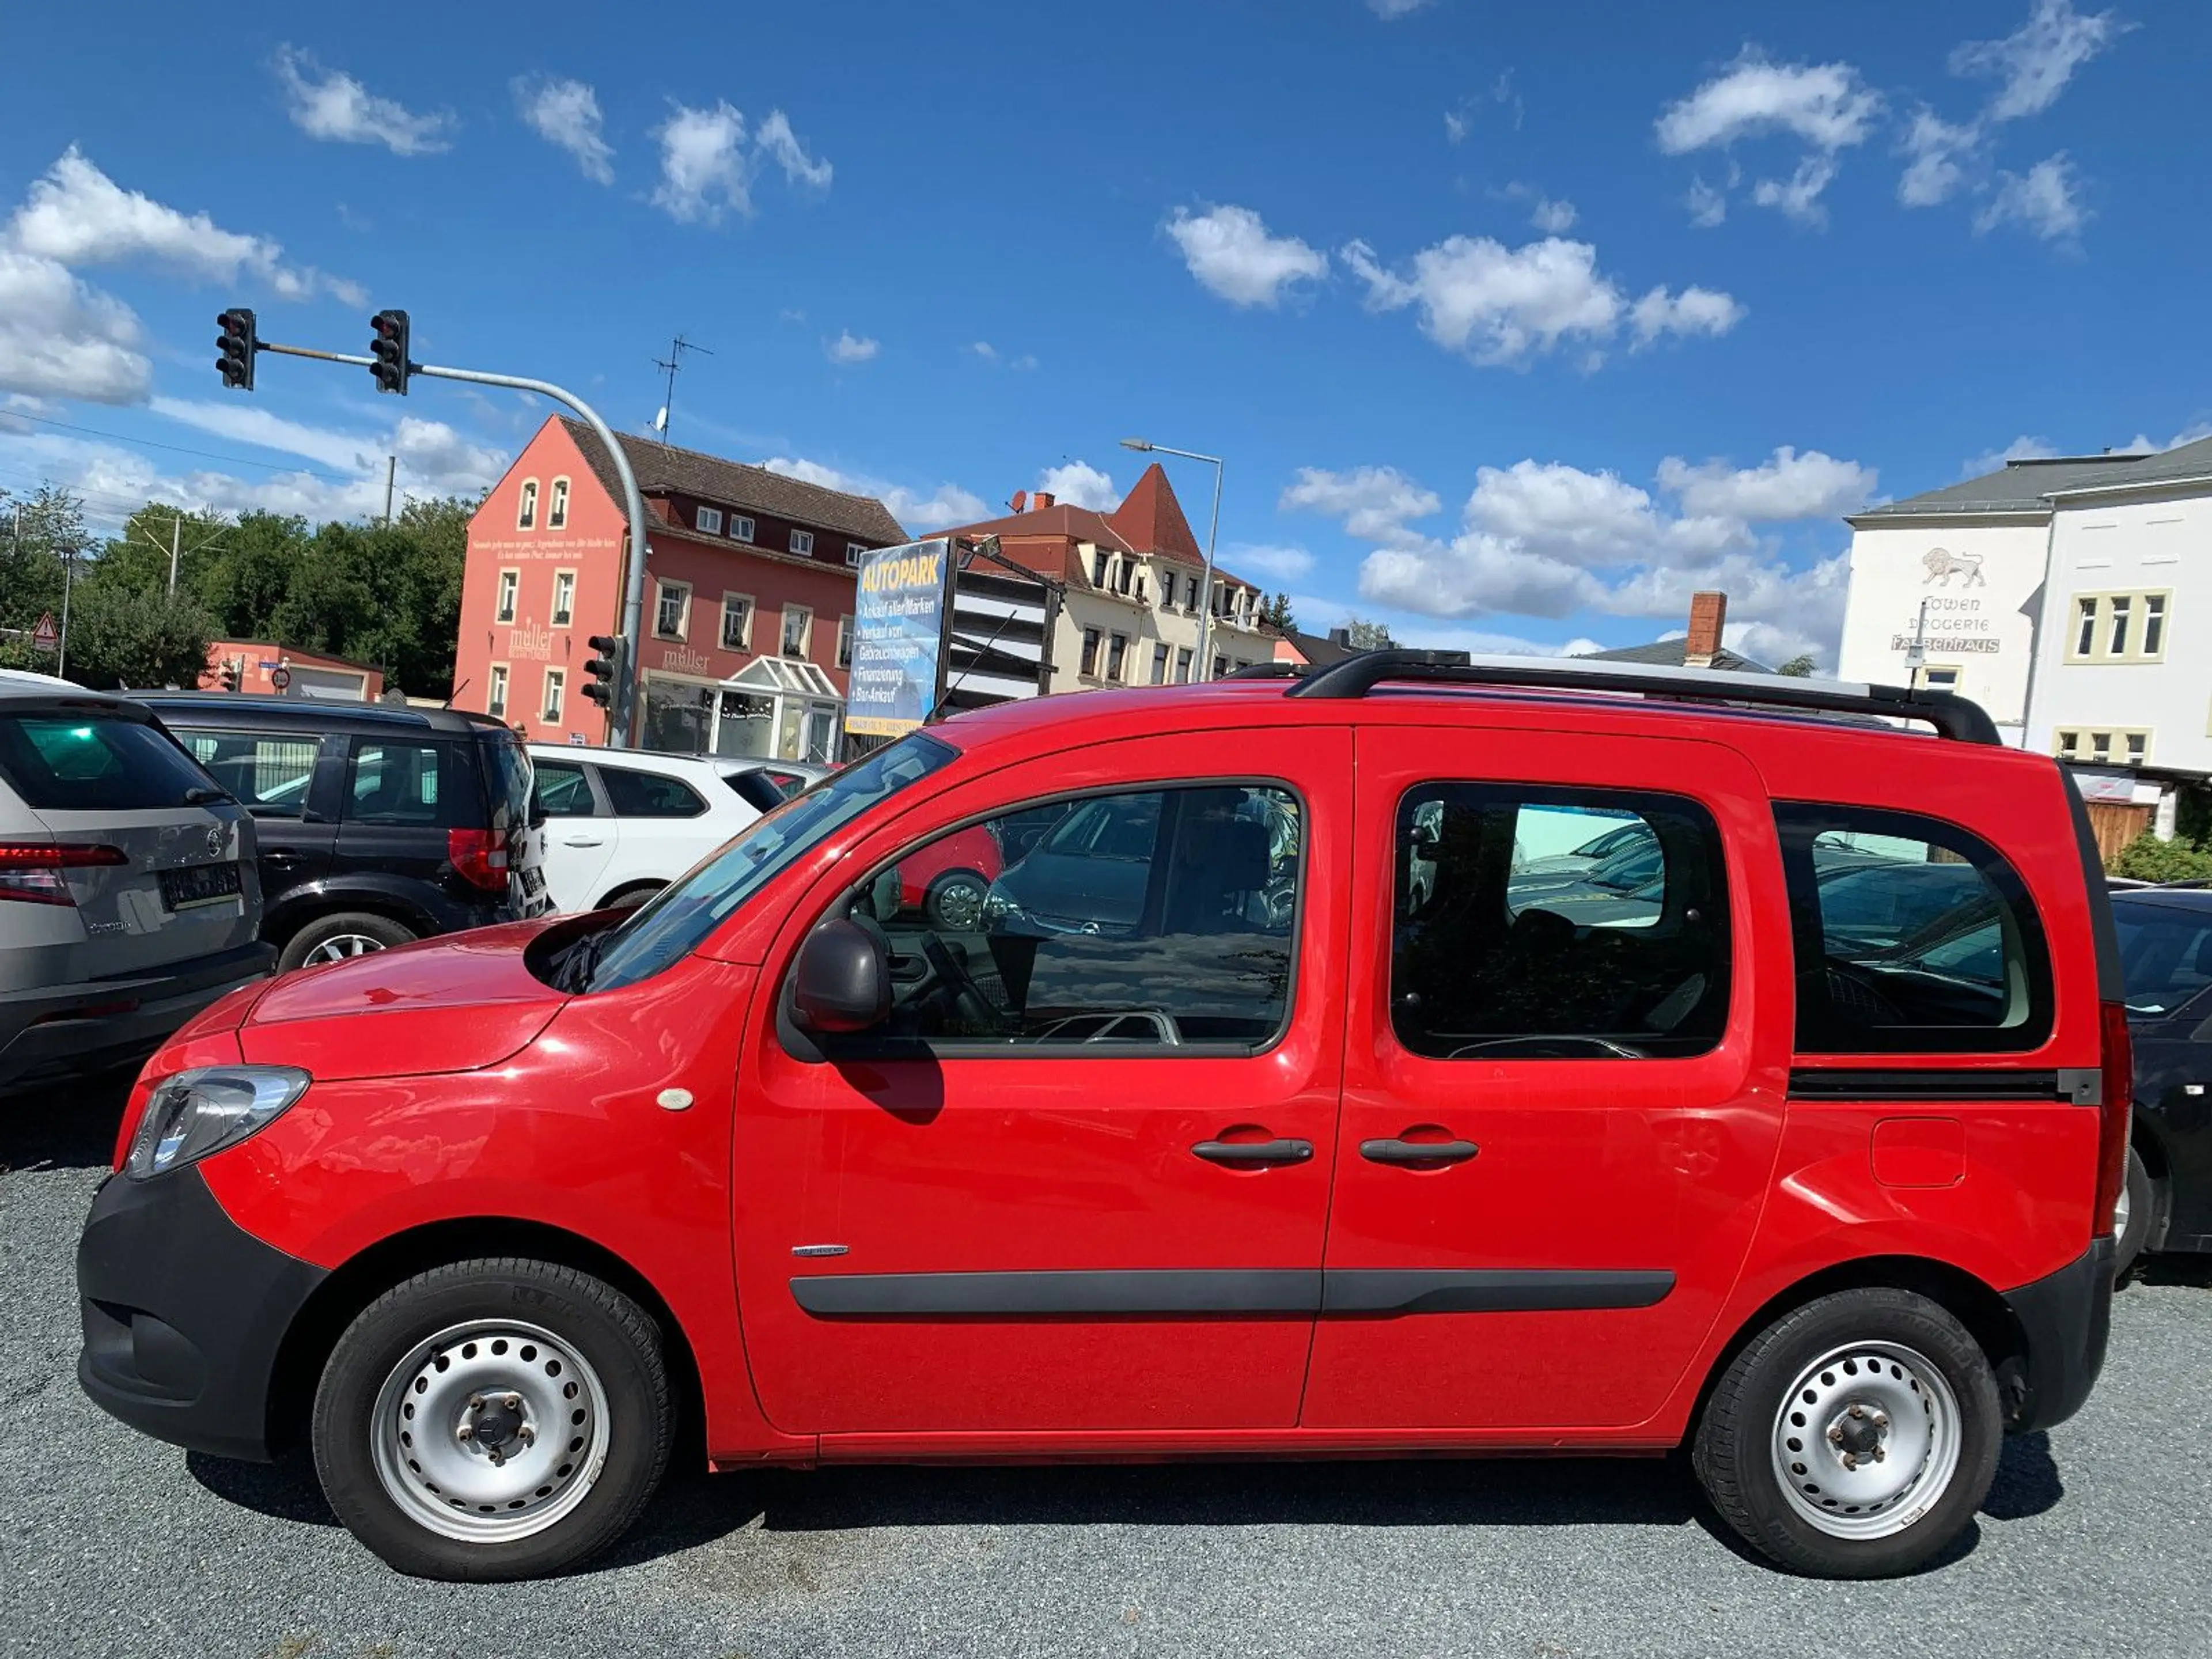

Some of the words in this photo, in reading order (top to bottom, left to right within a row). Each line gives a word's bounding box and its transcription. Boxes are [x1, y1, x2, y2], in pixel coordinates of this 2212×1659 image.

[862, 554, 940, 592] AUTOPARK
[863, 601, 888, 619] Ankauf
[906, 597, 934, 616] Marken
[858, 666, 904, 686] Finanzierung
